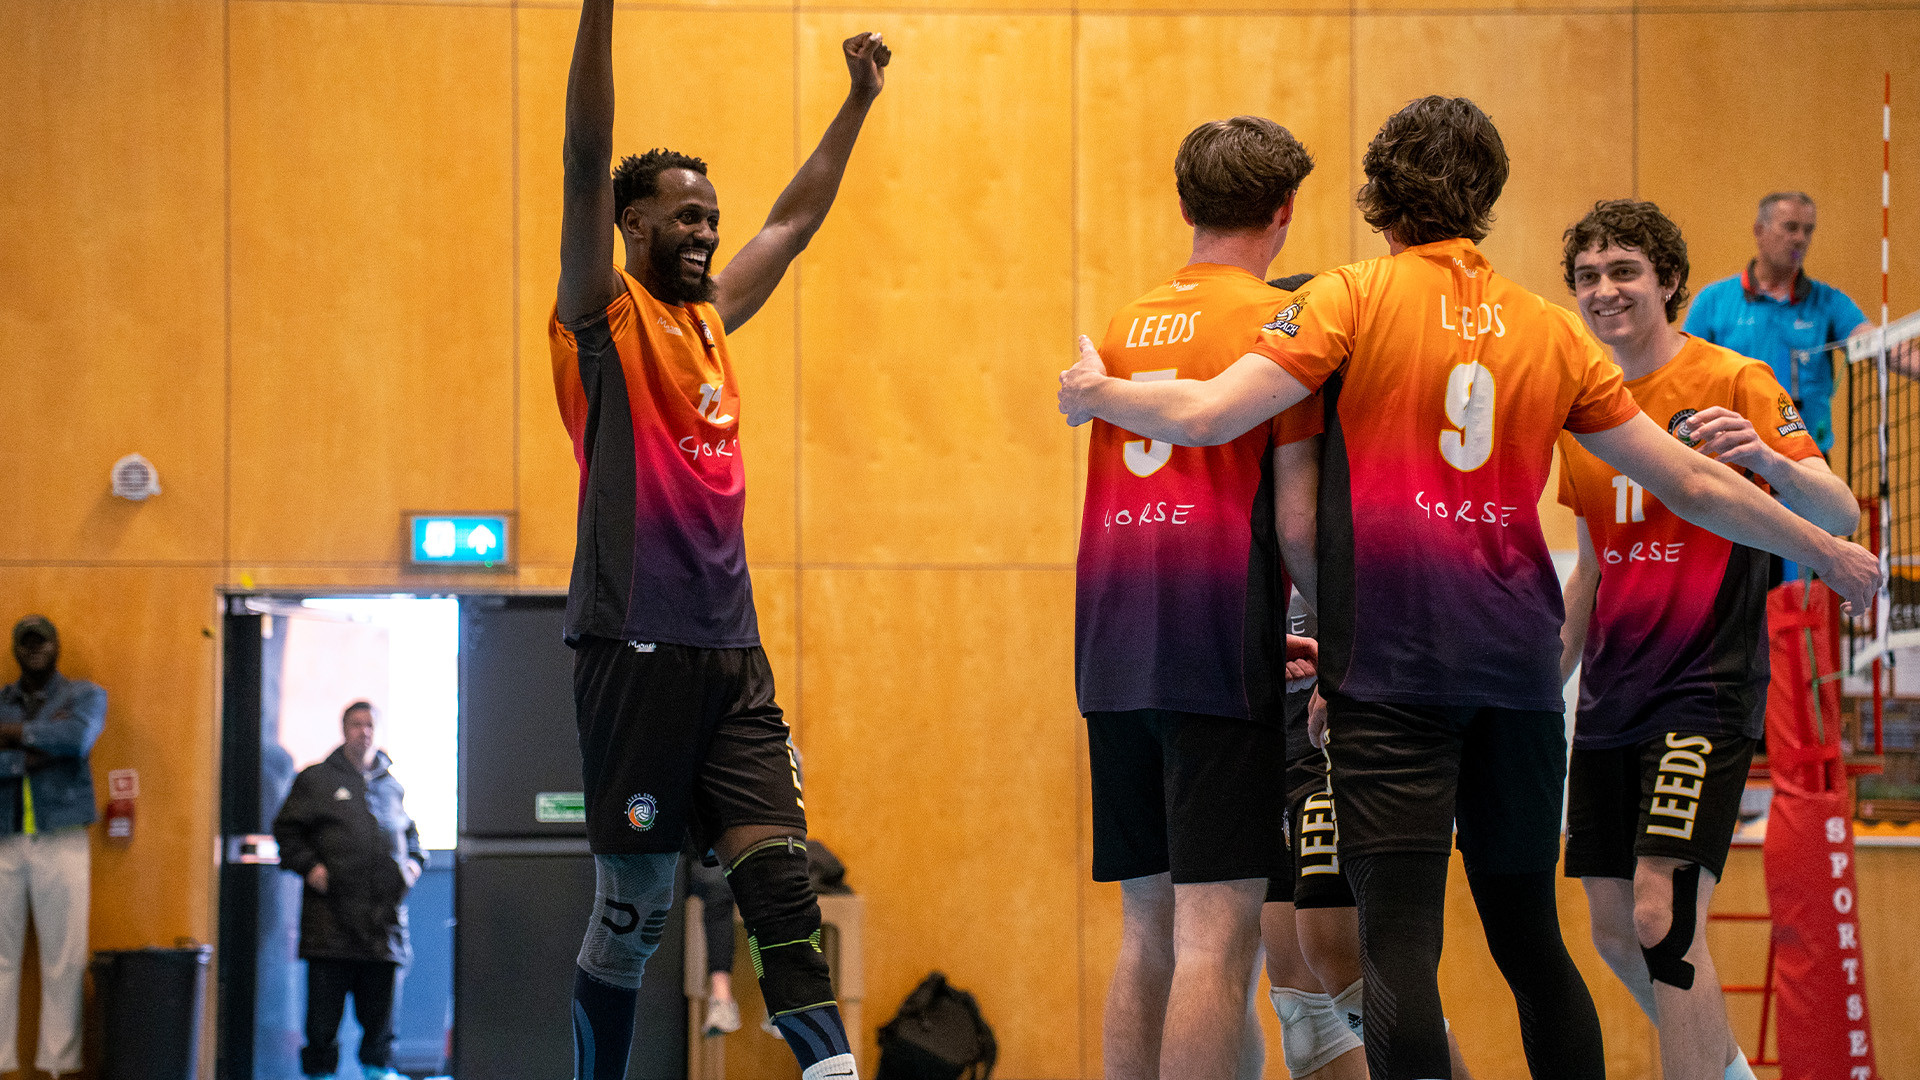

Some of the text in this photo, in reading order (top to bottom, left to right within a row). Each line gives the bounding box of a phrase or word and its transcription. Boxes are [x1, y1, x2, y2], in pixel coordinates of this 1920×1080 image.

[1125, 311, 1201, 349] LEEDS
[1441, 294, 1506, 341] LEDS
[1439, 360, 1496, 472] 9
[679, 436, 738, 461] GOR
[1612, 475, 1645, 524] 11
[1603, 542, 1684, 565] ORSE
[1646, 732, 1713, 841] LEEDS
